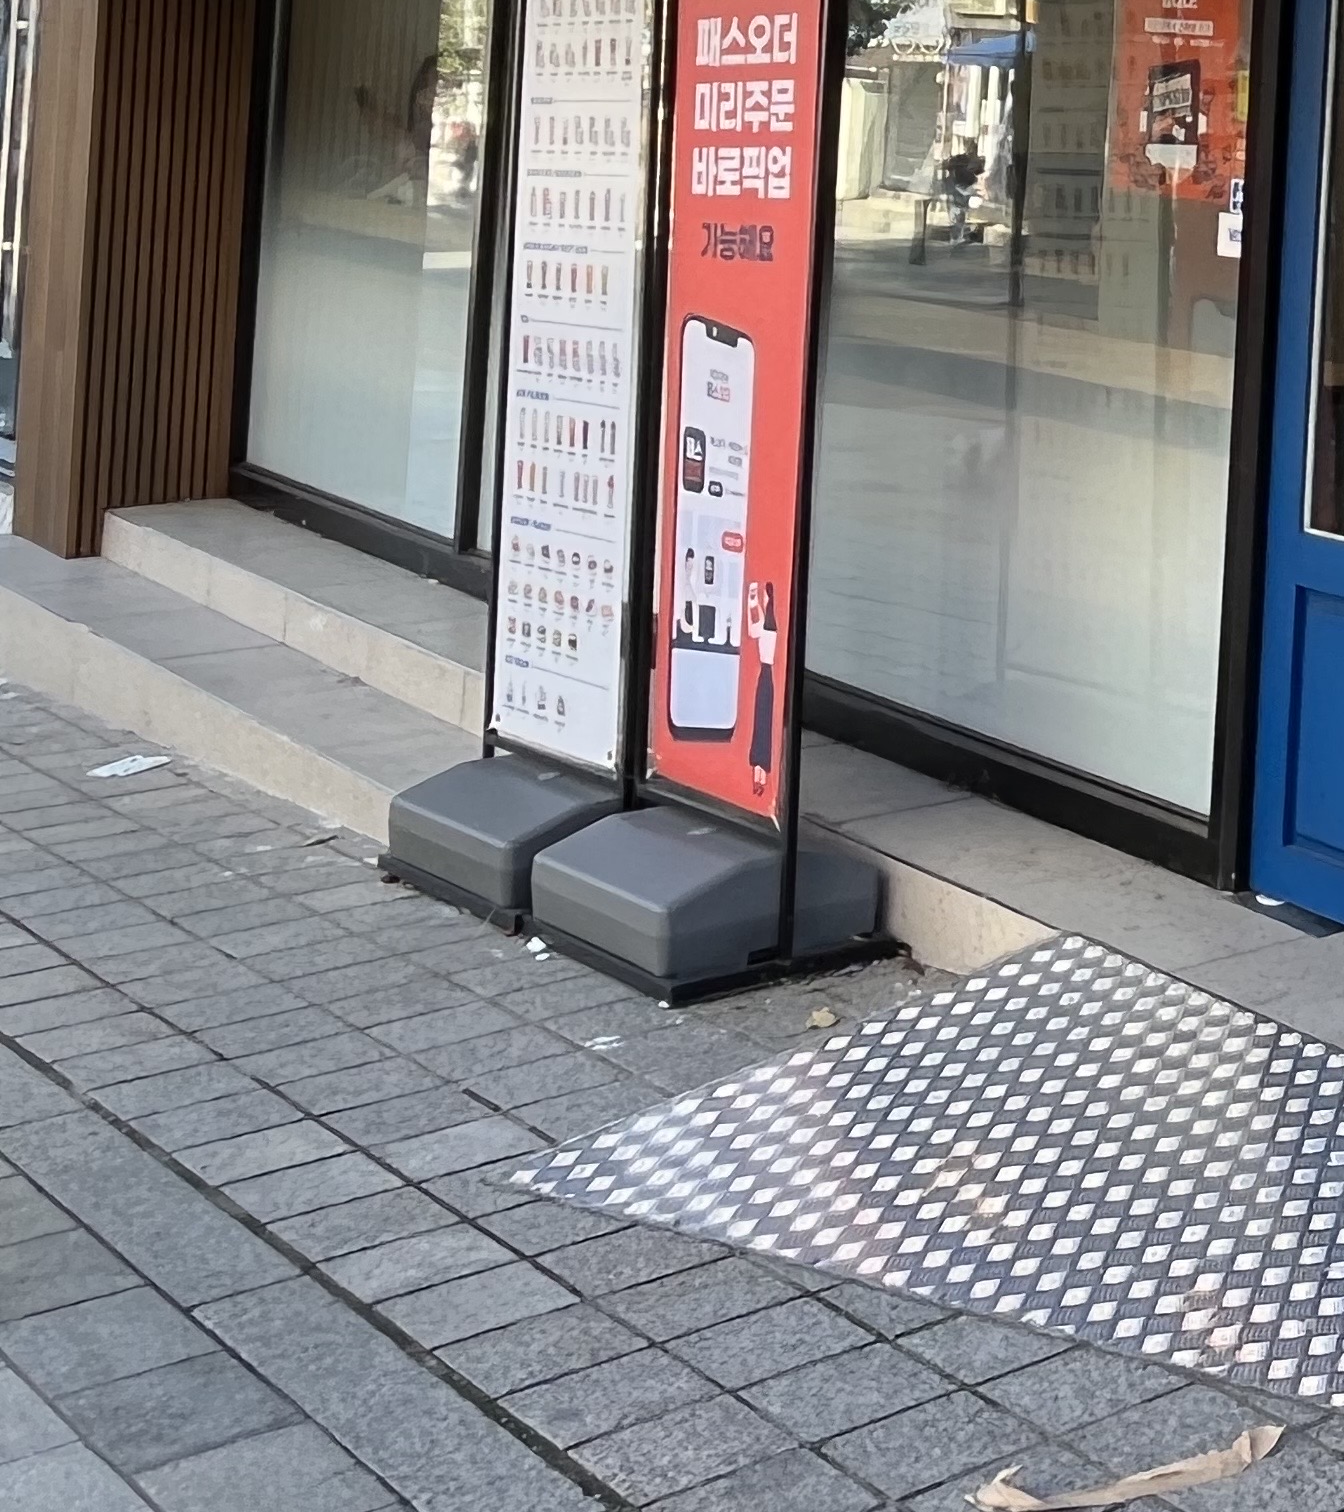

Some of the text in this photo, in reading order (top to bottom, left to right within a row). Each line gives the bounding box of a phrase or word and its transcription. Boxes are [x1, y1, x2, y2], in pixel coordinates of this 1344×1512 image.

[696, 12, 798, 67] 패스오더
[694, 79, 794, 132] 미리주문
[691, 146, 792, 200] 바로픽업
